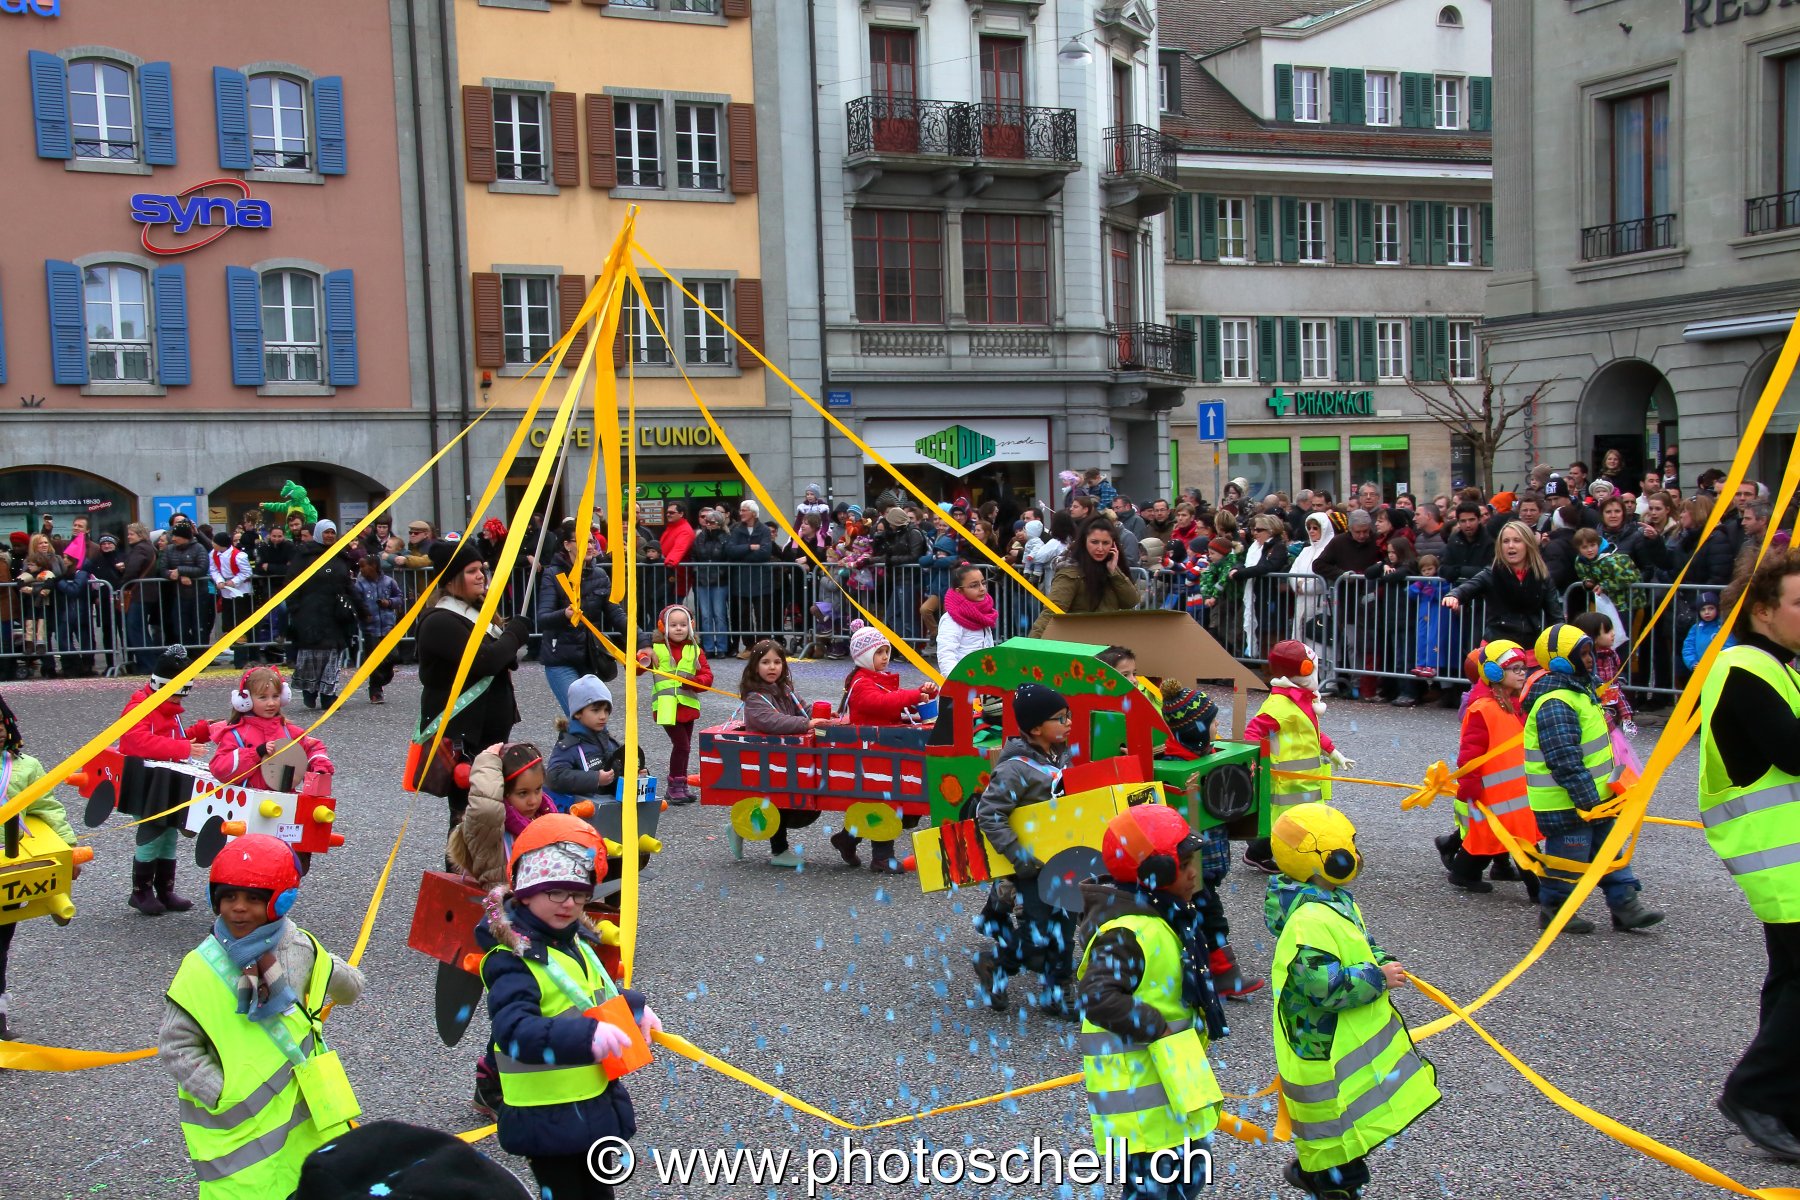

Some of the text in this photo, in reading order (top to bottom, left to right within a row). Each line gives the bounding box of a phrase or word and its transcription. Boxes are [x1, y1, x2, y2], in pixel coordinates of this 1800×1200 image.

[130, 193, 272, 234] syna
[1295, 390, 1375, 416] PHARMACIE
[529, 426, 591, 448] CFE
[915, 424, 996, 470] PICCADILLY
